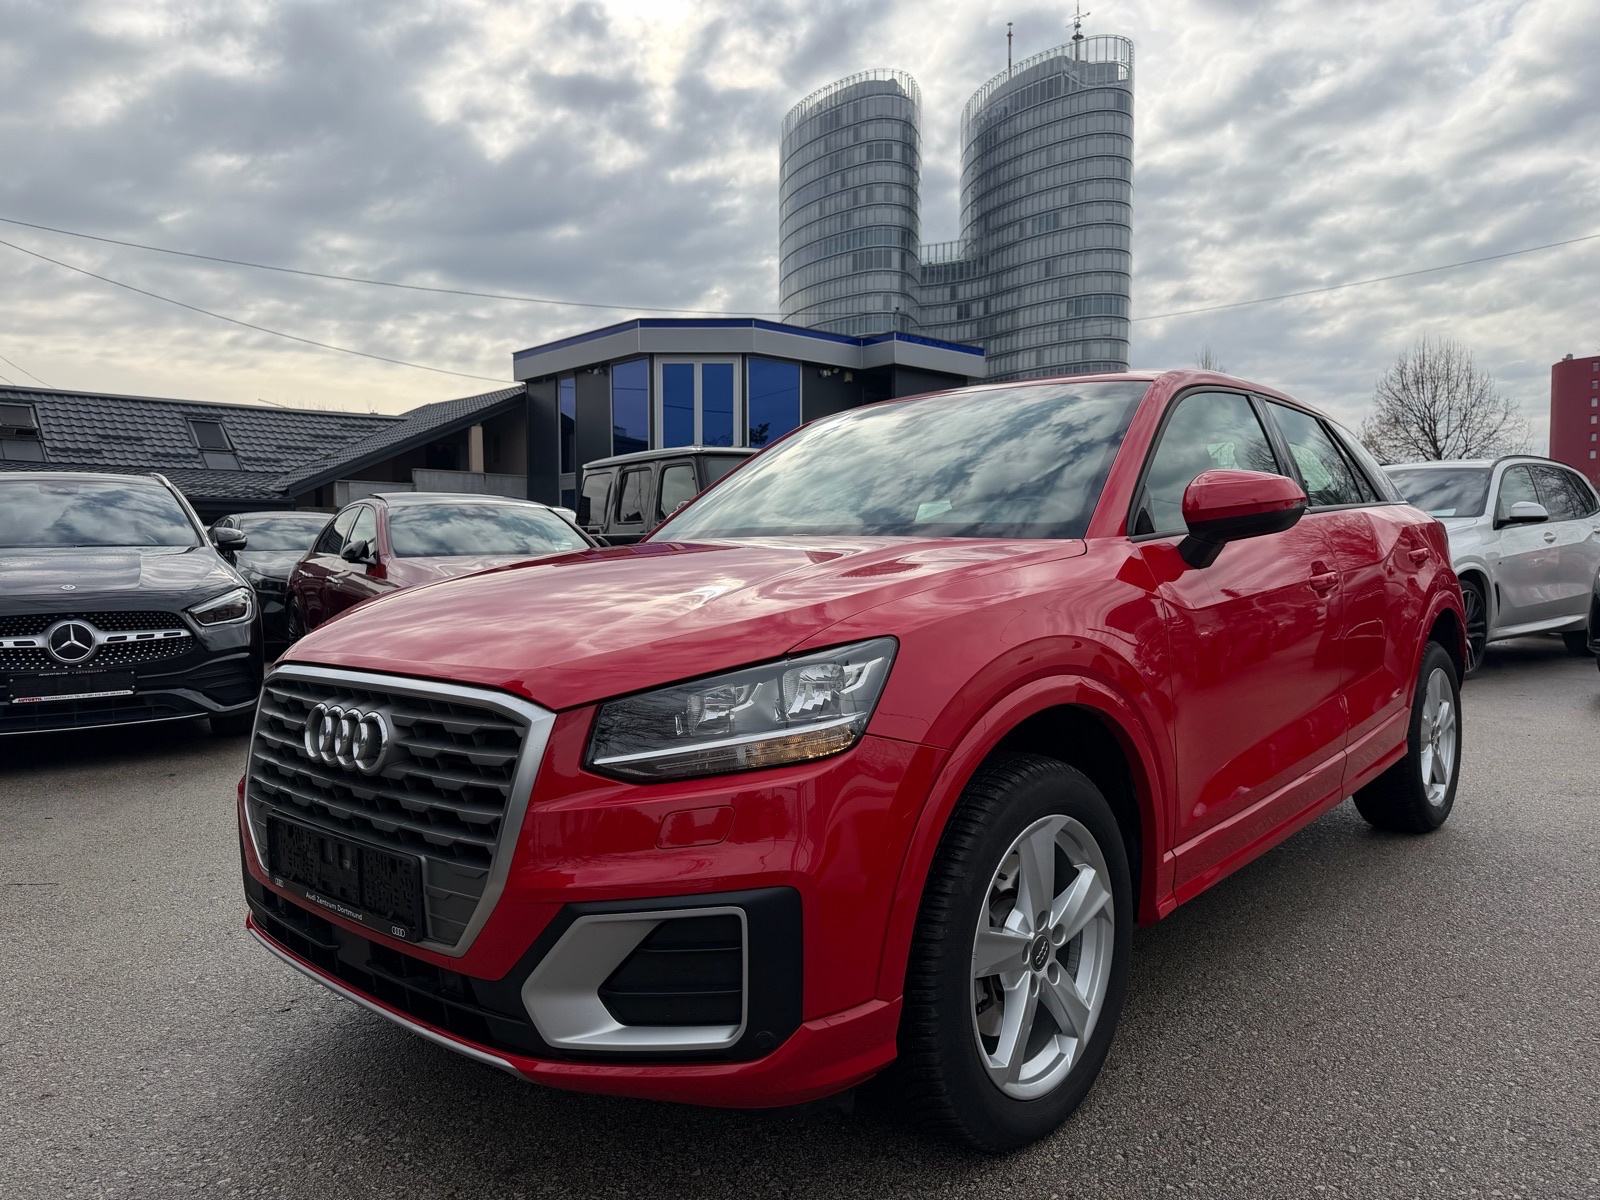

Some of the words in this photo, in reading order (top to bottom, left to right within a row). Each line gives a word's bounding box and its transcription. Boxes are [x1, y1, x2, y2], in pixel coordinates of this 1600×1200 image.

[305, 891, 316, 901] Audi
[316, 896, 337, 910] Zentrum
[337, 904, 363, 921] Dortmund
